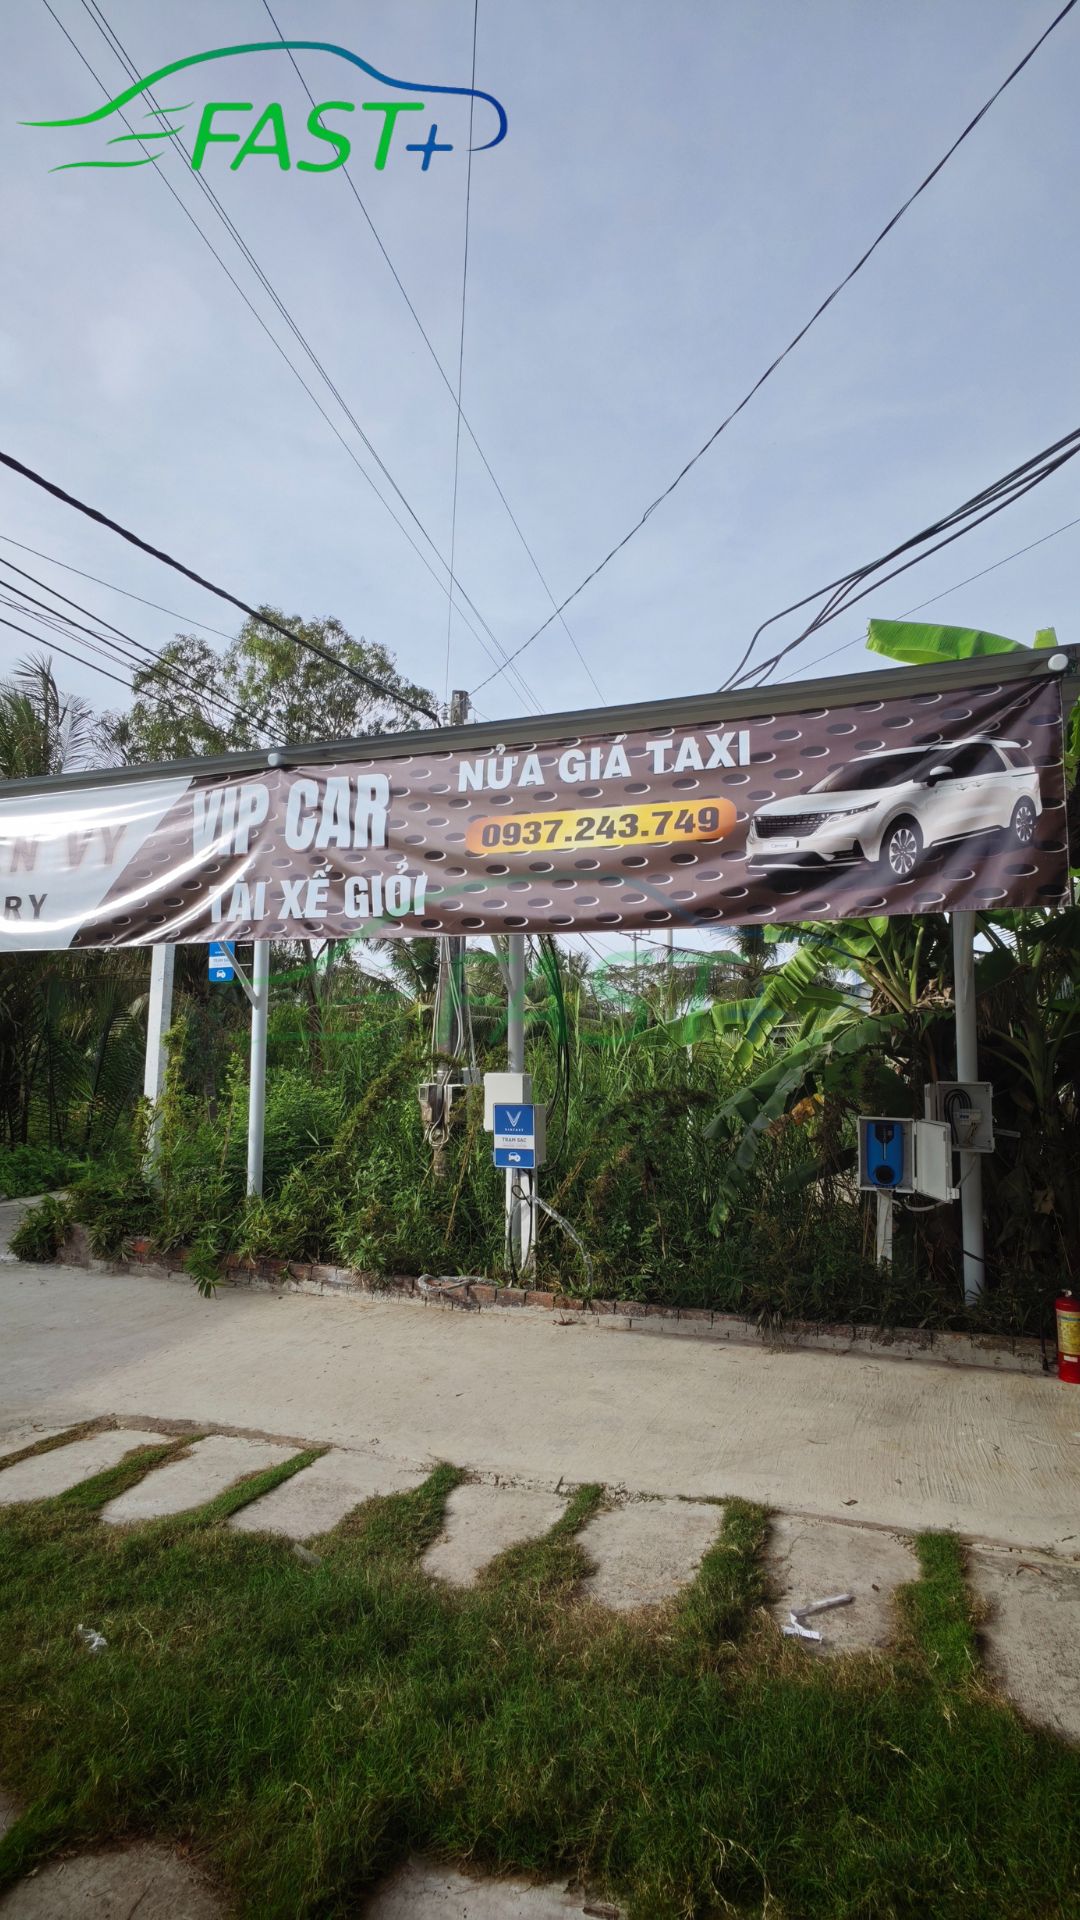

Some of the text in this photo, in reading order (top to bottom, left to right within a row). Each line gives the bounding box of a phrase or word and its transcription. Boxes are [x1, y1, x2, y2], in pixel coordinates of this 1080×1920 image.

[457, 730, 751, 792] NỬA GIÁ TAXI
[66, 824, 128, 867] VY
[192, 773, 390, 858] VIP CAR
[481, 806, 720, 847] 0937.243.749
[208, 861, 429, 923] TÀI XẾ GIỎI
